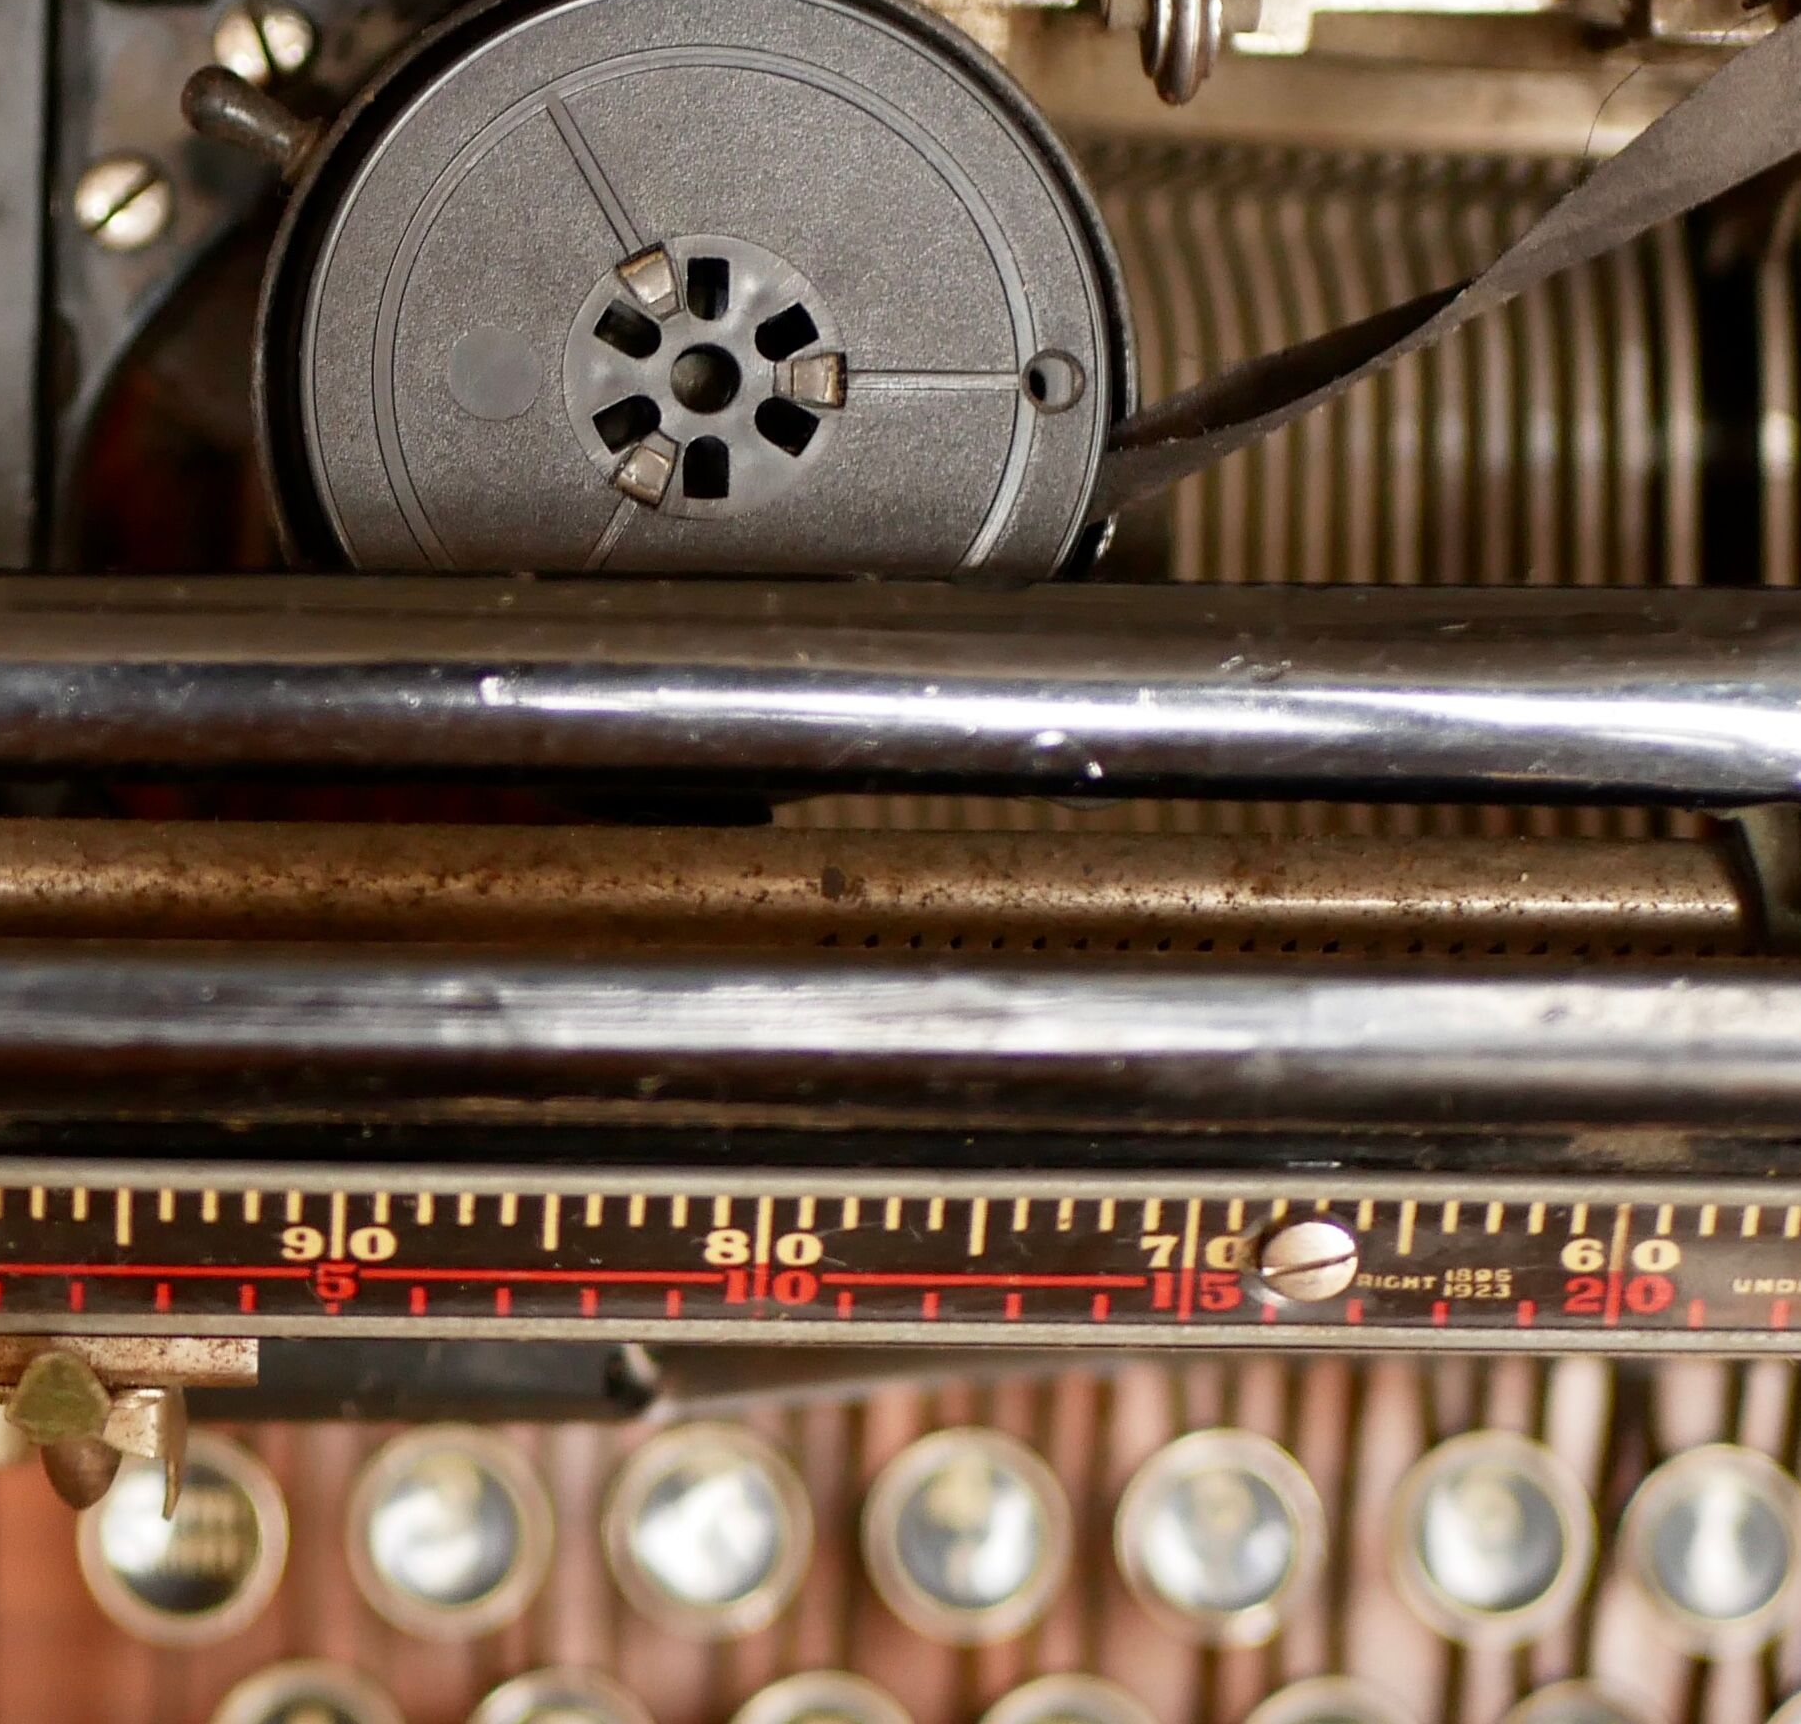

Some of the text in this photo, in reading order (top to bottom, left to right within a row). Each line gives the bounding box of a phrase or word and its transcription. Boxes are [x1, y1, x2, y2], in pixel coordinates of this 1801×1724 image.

[315, 1262, 359, 1301] 5
[1355, 1272, 1437, 1290] RIGHT
[1731, 1277, 1801, 1294] UND
[1443, 1282, 1513, 1298] 1923
